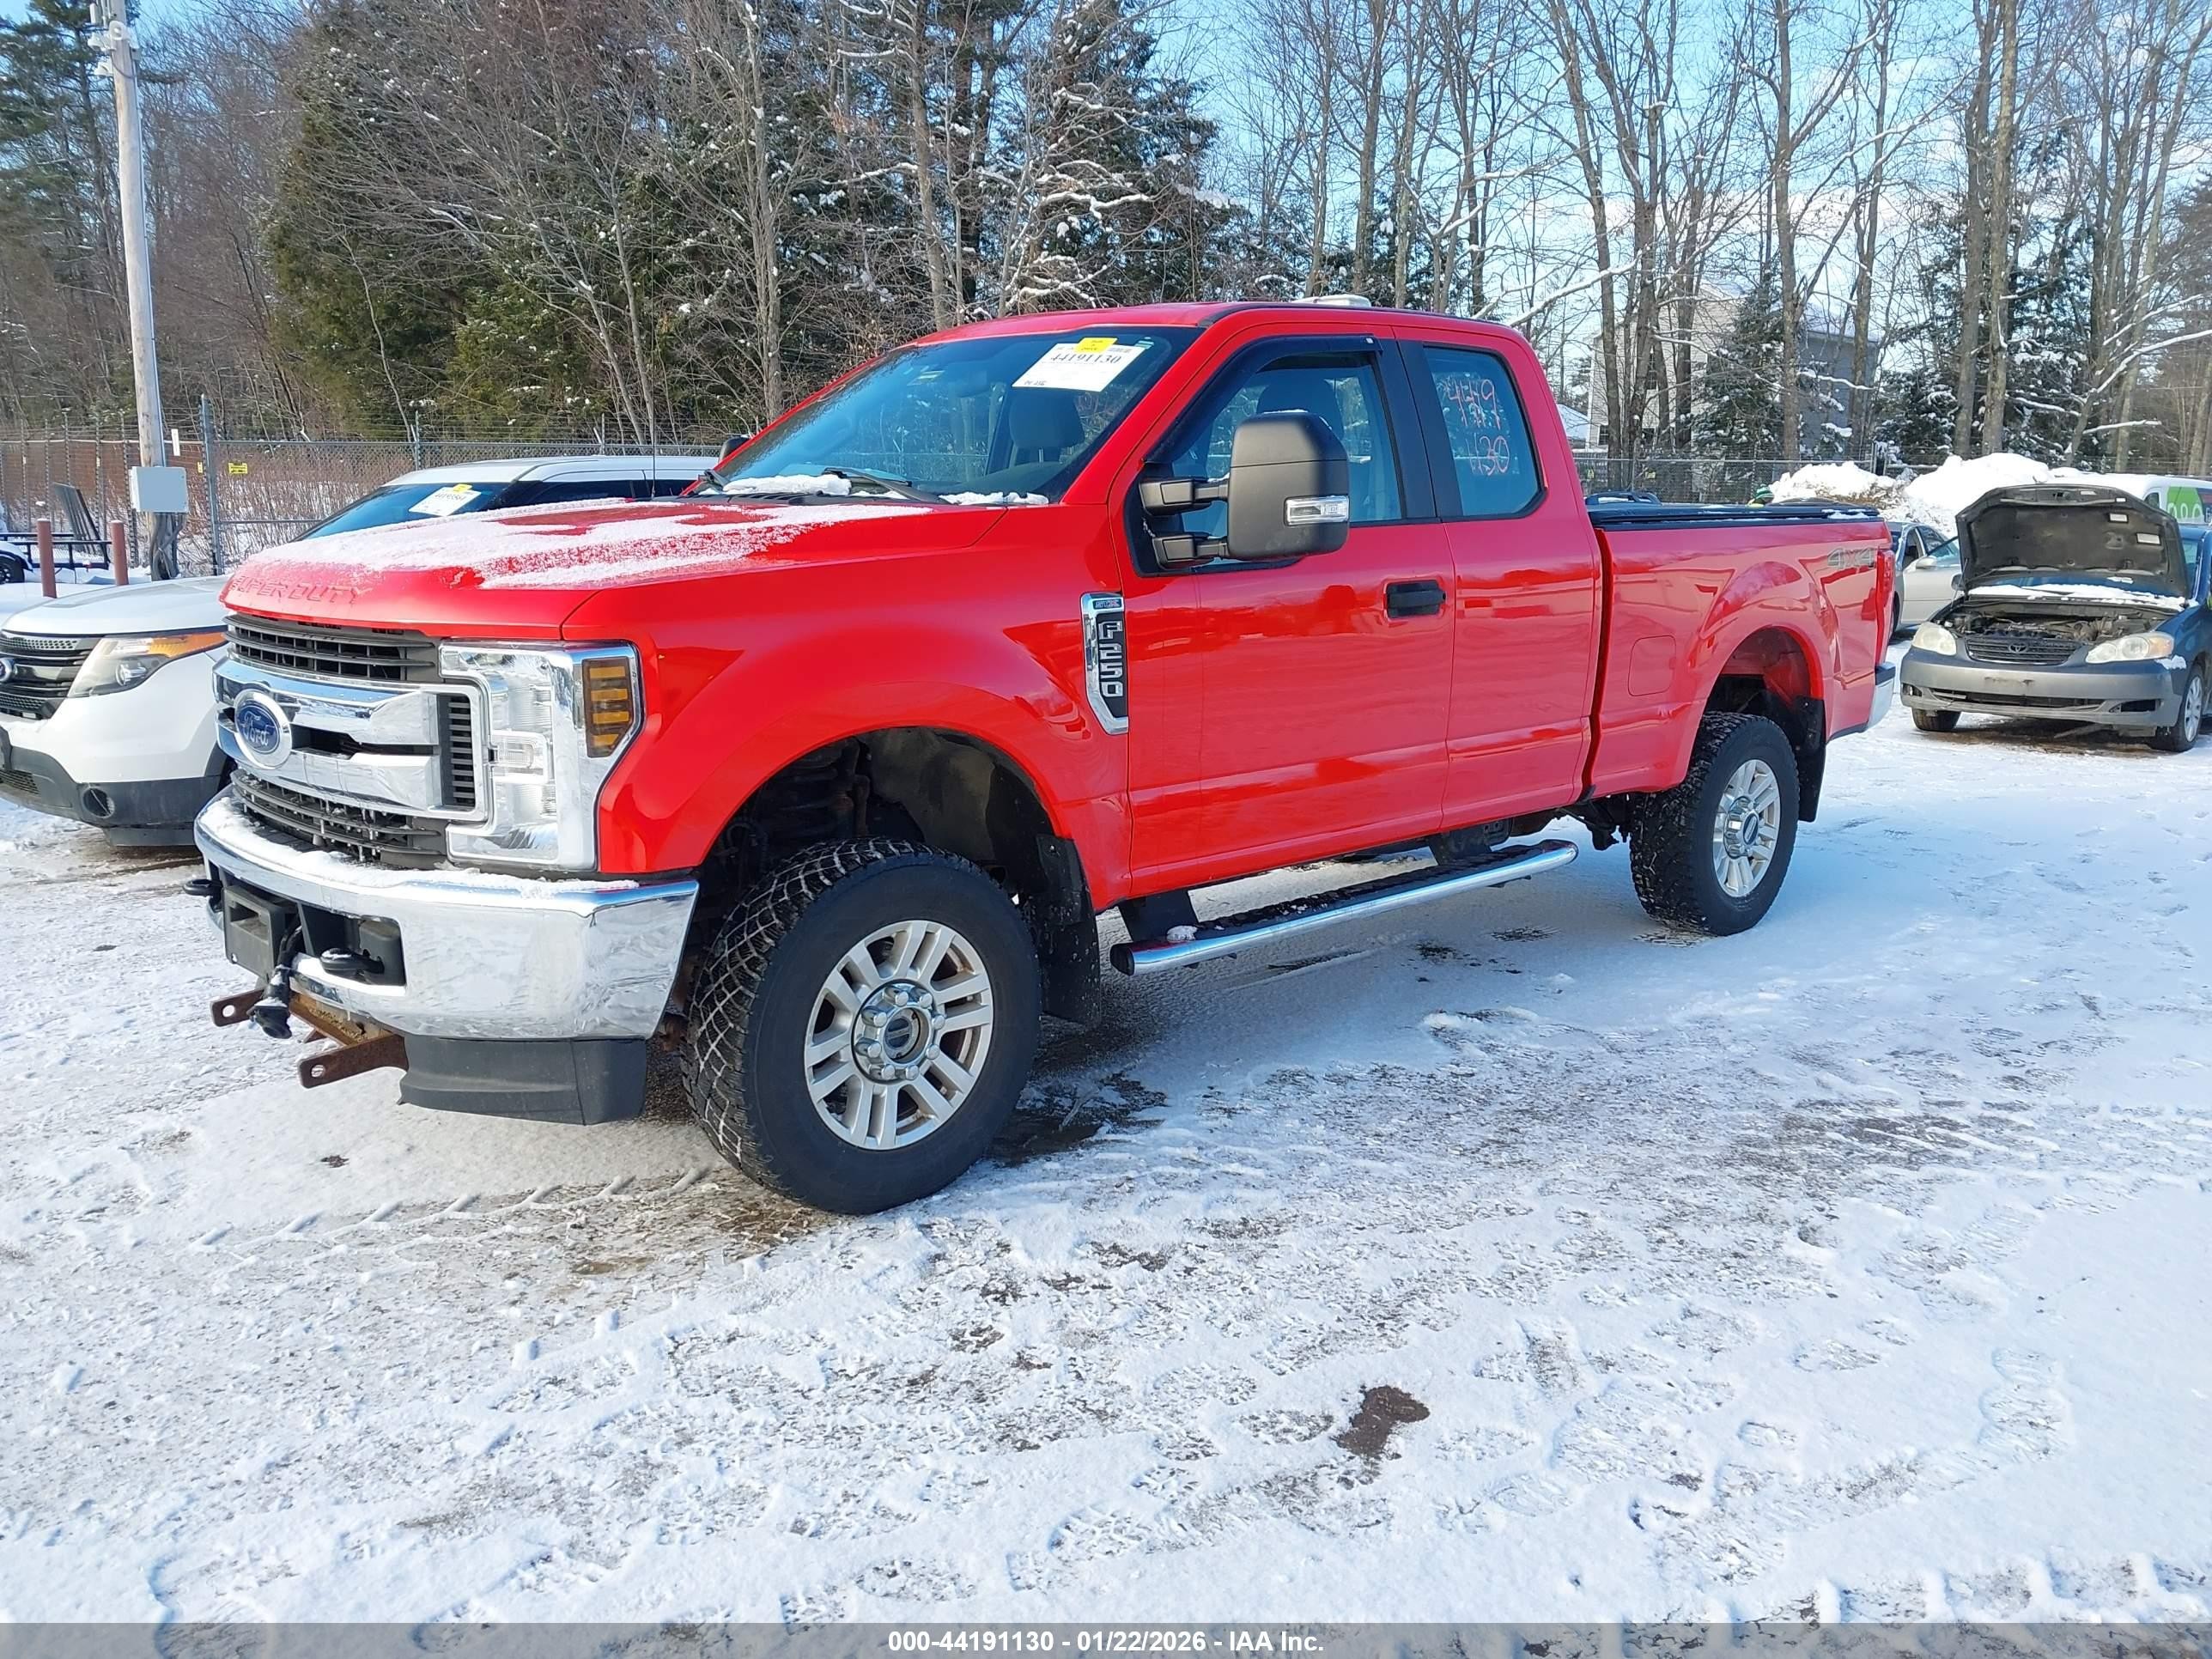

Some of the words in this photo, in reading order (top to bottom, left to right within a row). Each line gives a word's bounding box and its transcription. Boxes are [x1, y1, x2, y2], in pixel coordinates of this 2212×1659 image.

[1049, 353, 1122, 365] 44191130
[288, 580, 373, 604] DUTY
[240, 710, 275, 746] Ford
